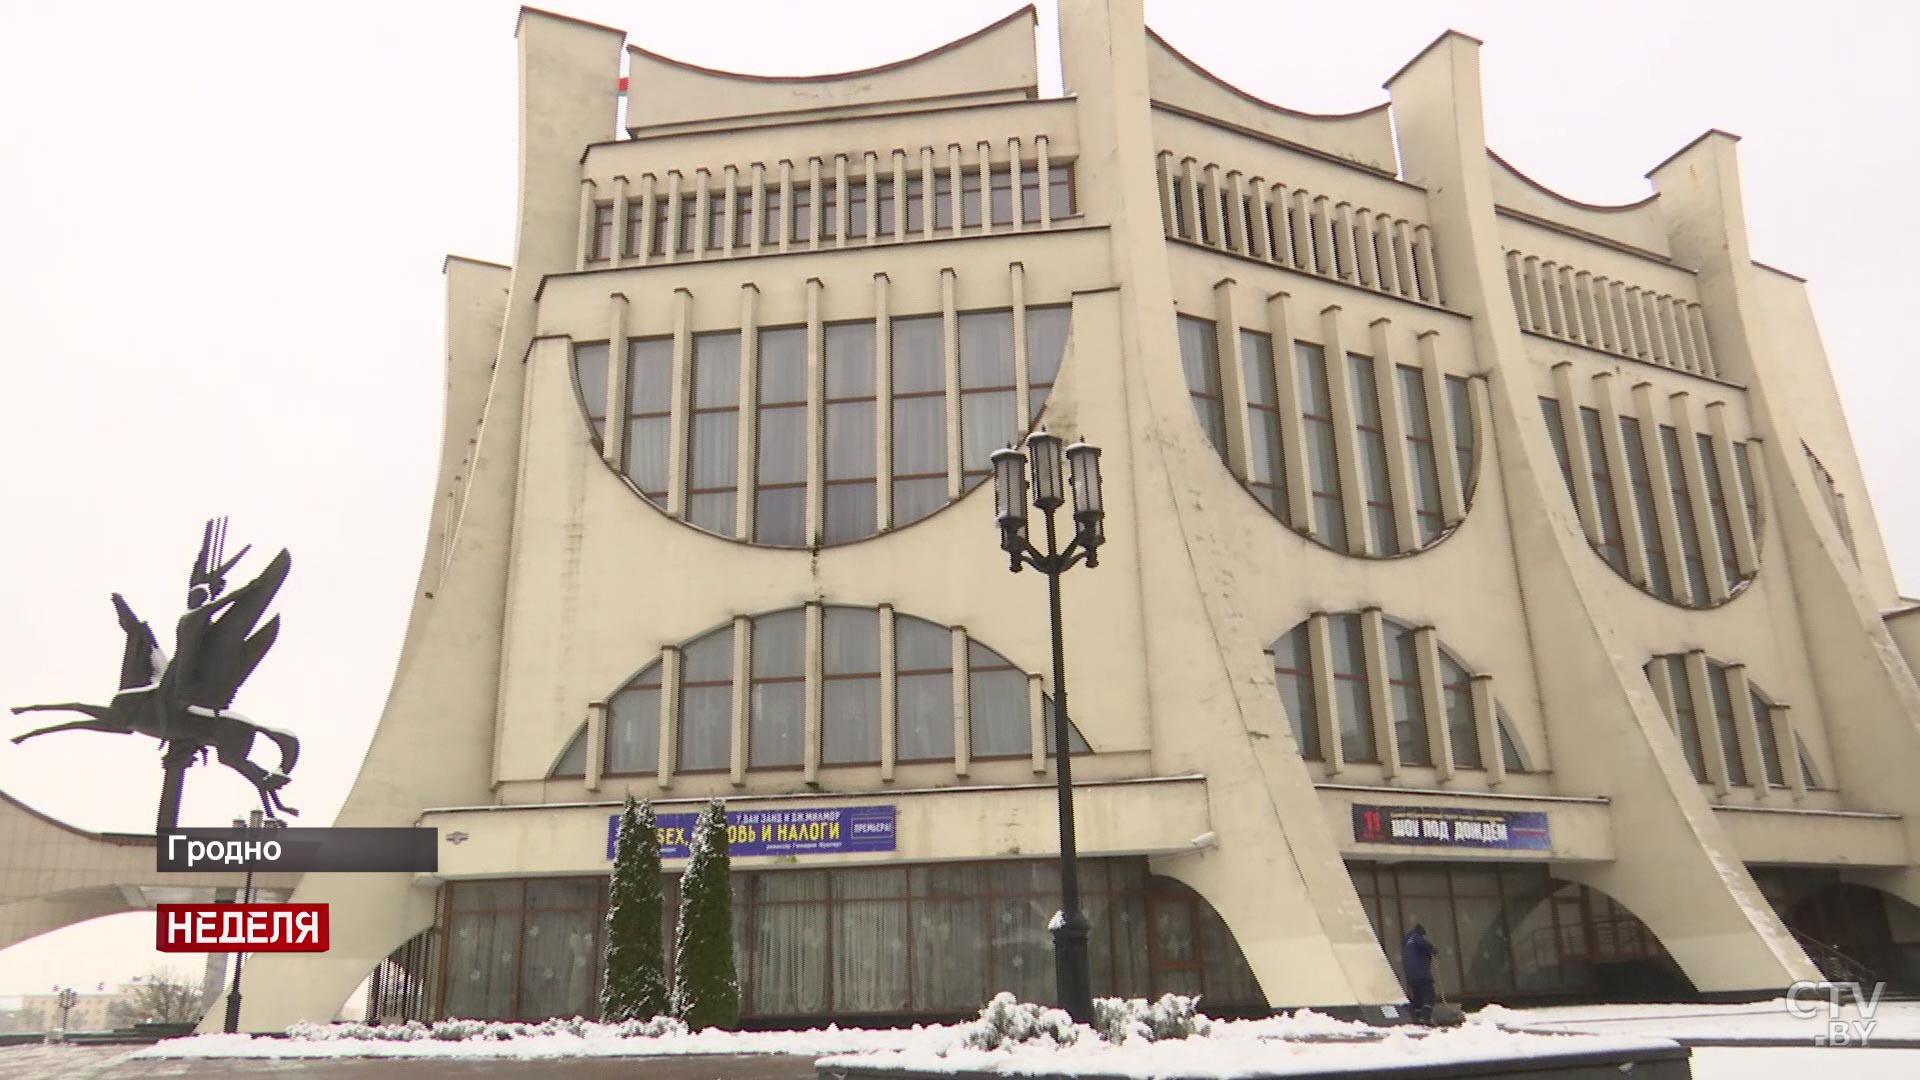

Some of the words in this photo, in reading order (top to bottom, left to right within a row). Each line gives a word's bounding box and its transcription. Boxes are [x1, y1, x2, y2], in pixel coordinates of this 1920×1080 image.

[783, 813, 790, 823] И
[656, 827, 689, 846] SEX,
[761, 824, 772, 842] И
[777, 822, 841, 842] НАЛОГИ
[1391, 819, 1420, 838] ШОУ
[1421, 819, 1450, 841] ПОД
